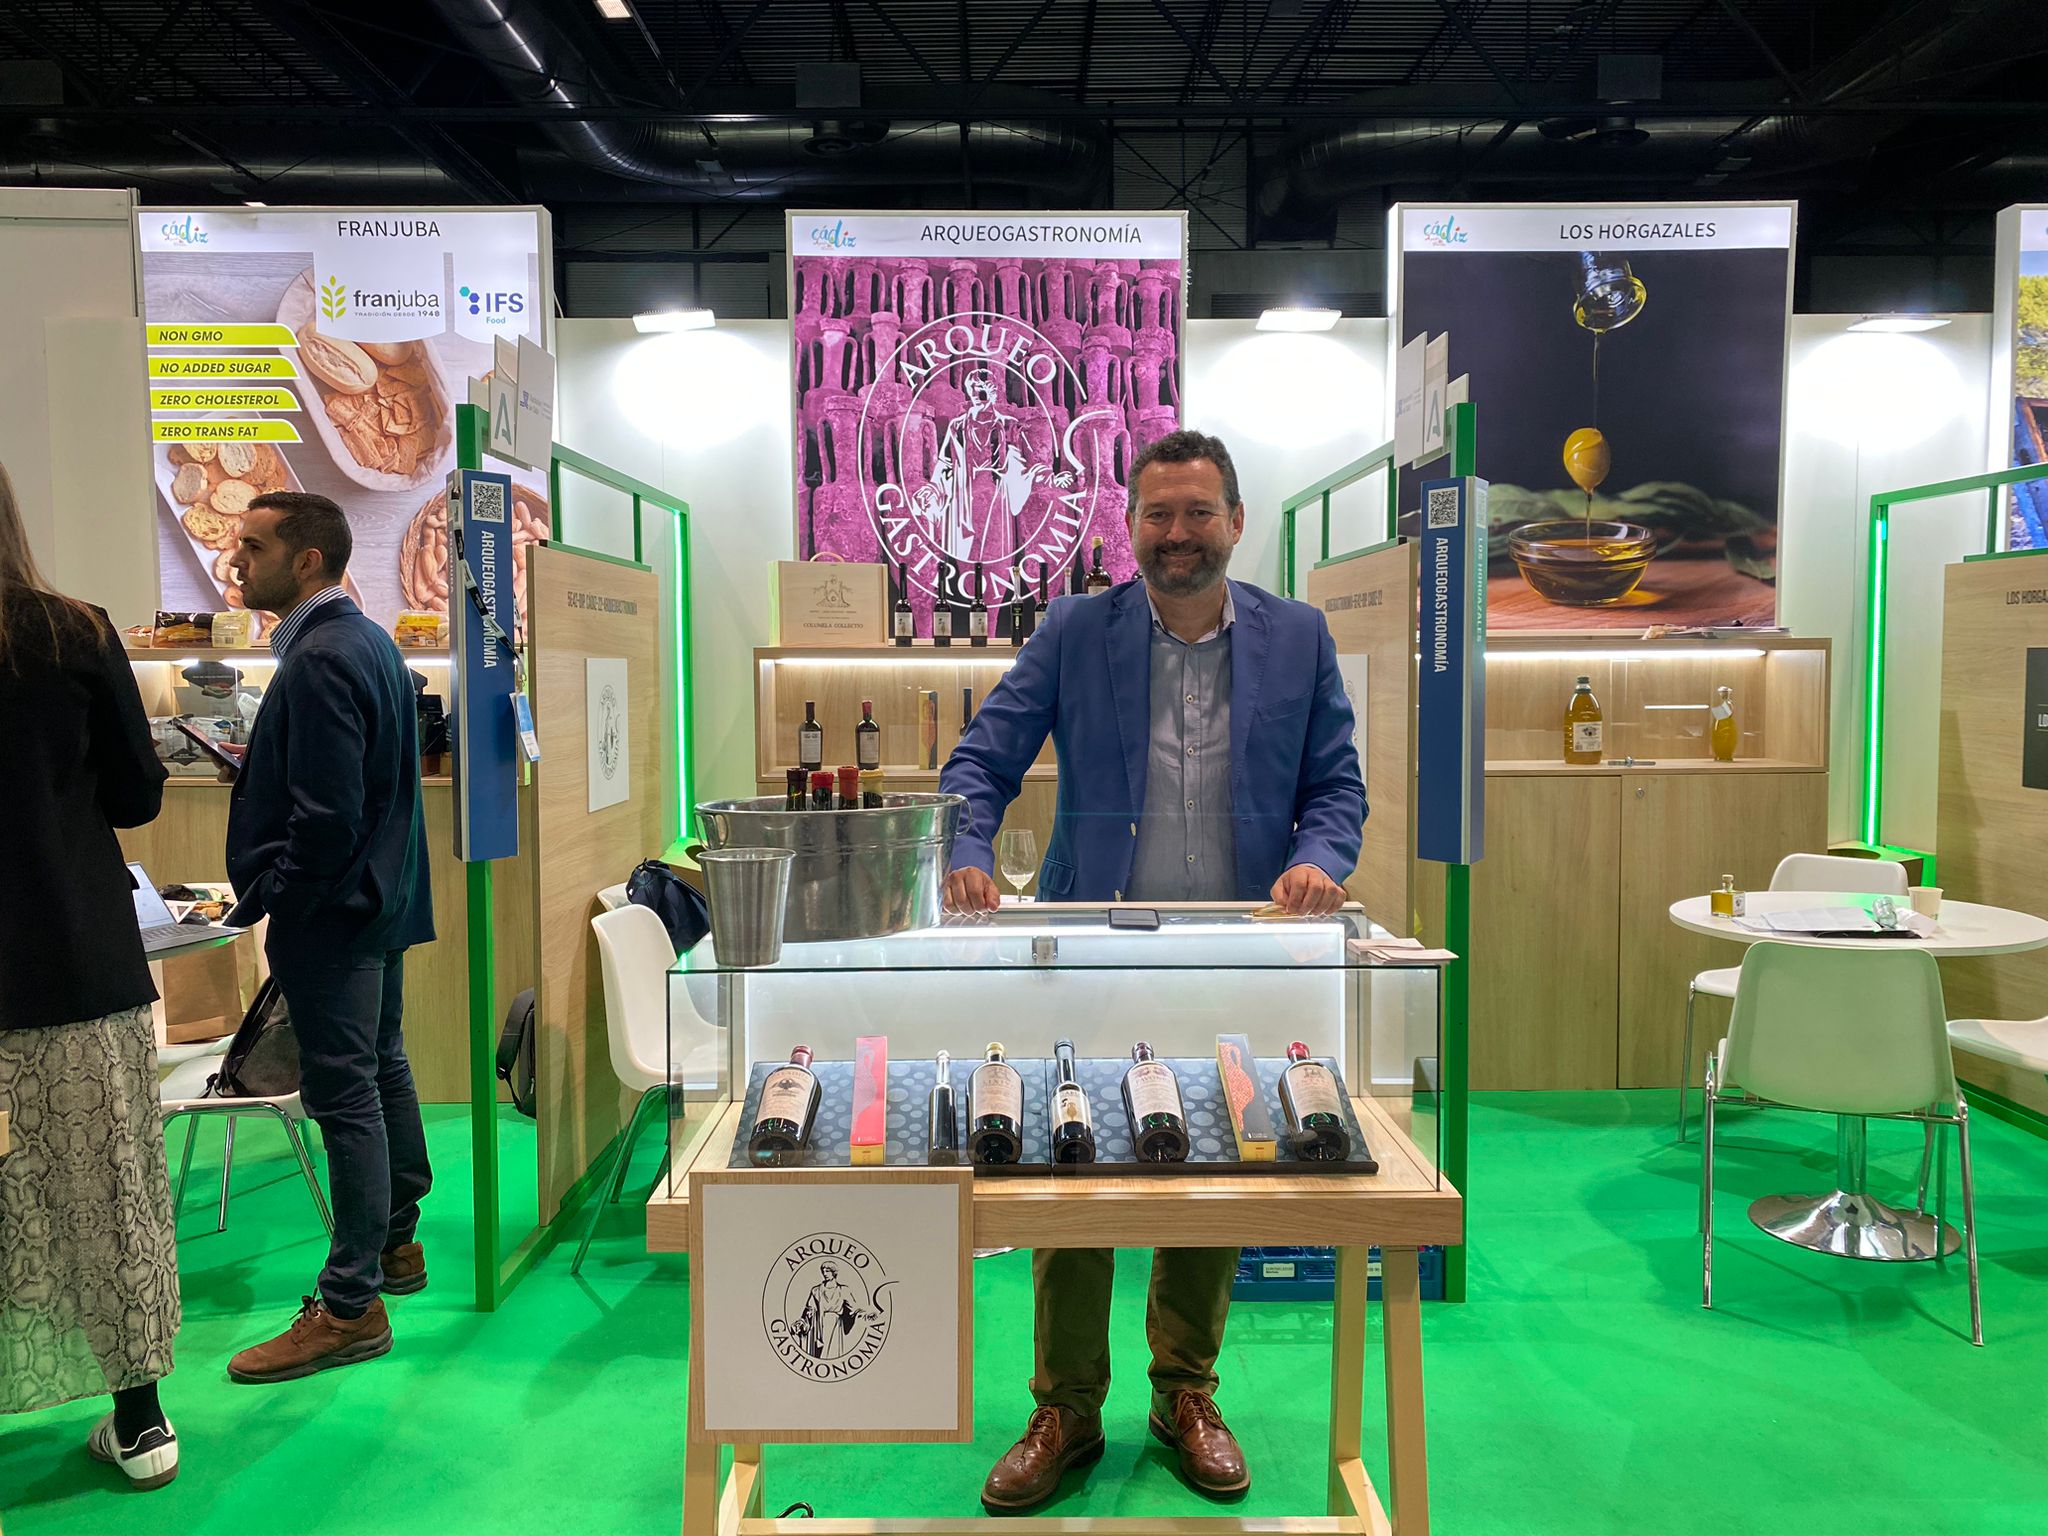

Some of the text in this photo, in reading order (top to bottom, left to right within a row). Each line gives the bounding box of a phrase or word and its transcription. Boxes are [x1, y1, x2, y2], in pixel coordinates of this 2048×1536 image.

[338, 220, 441, 238] FRANJUBA
[920, 223, 1142, 245] ARQUEOGASTRONOMÍA
[1559, 222, 1717, 240] LOS HORGAZALES
[353, 290, 440, 311] franjuba
[486, 293, 524, 313] IFS
[417, 310, 440, 318] 1948
[486, 317, 506, 325] Food
[159, 331, 223, 341] NON GMO
[899, 323, 1056, 389] ARQUEO
[159, 363, 272, 373] NO ADDED SUGAR
[160, 395, 280, 405] ZERO CHOLESTEROL
[161, 427, 259, 437] ZERO TRANS FAT
[1435, 537, 1448, 673] ARQUEOGASTRONOMÍA
[2006, 591, 2020, 605] LOS
[785, 1238, 870, 1272] ARQUEO
[770, 1319, 886, 1379] GASTRONOMIA
